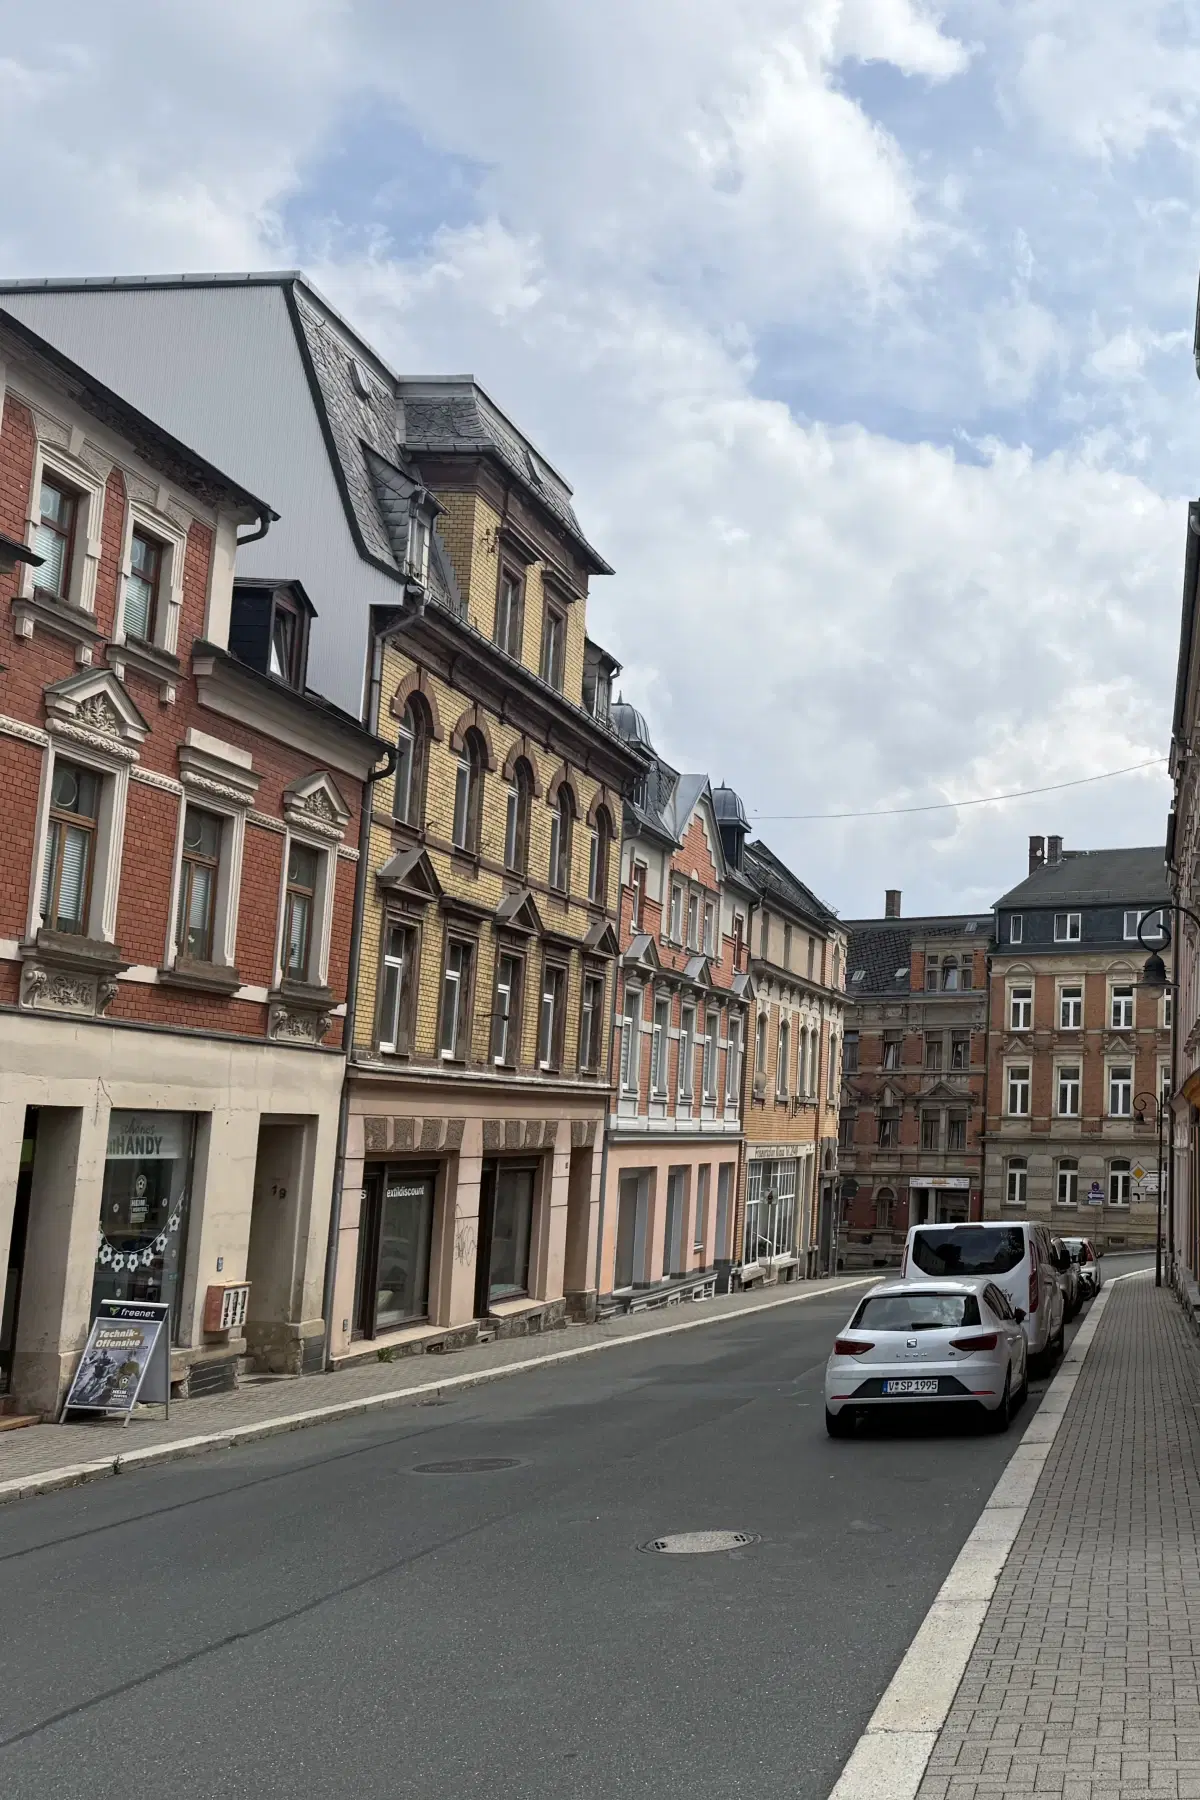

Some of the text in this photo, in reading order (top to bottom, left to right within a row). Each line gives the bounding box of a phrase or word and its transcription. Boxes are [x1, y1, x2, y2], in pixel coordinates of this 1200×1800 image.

[117, 1136, 163, 1155] HANDY
[121, 1308, 155, 1318] freenet
[99, 1329, 139, 1338] Technik-
[95, 1340, 140, 1348] Offensive
[914, 1380, 937, 1391] 1995
